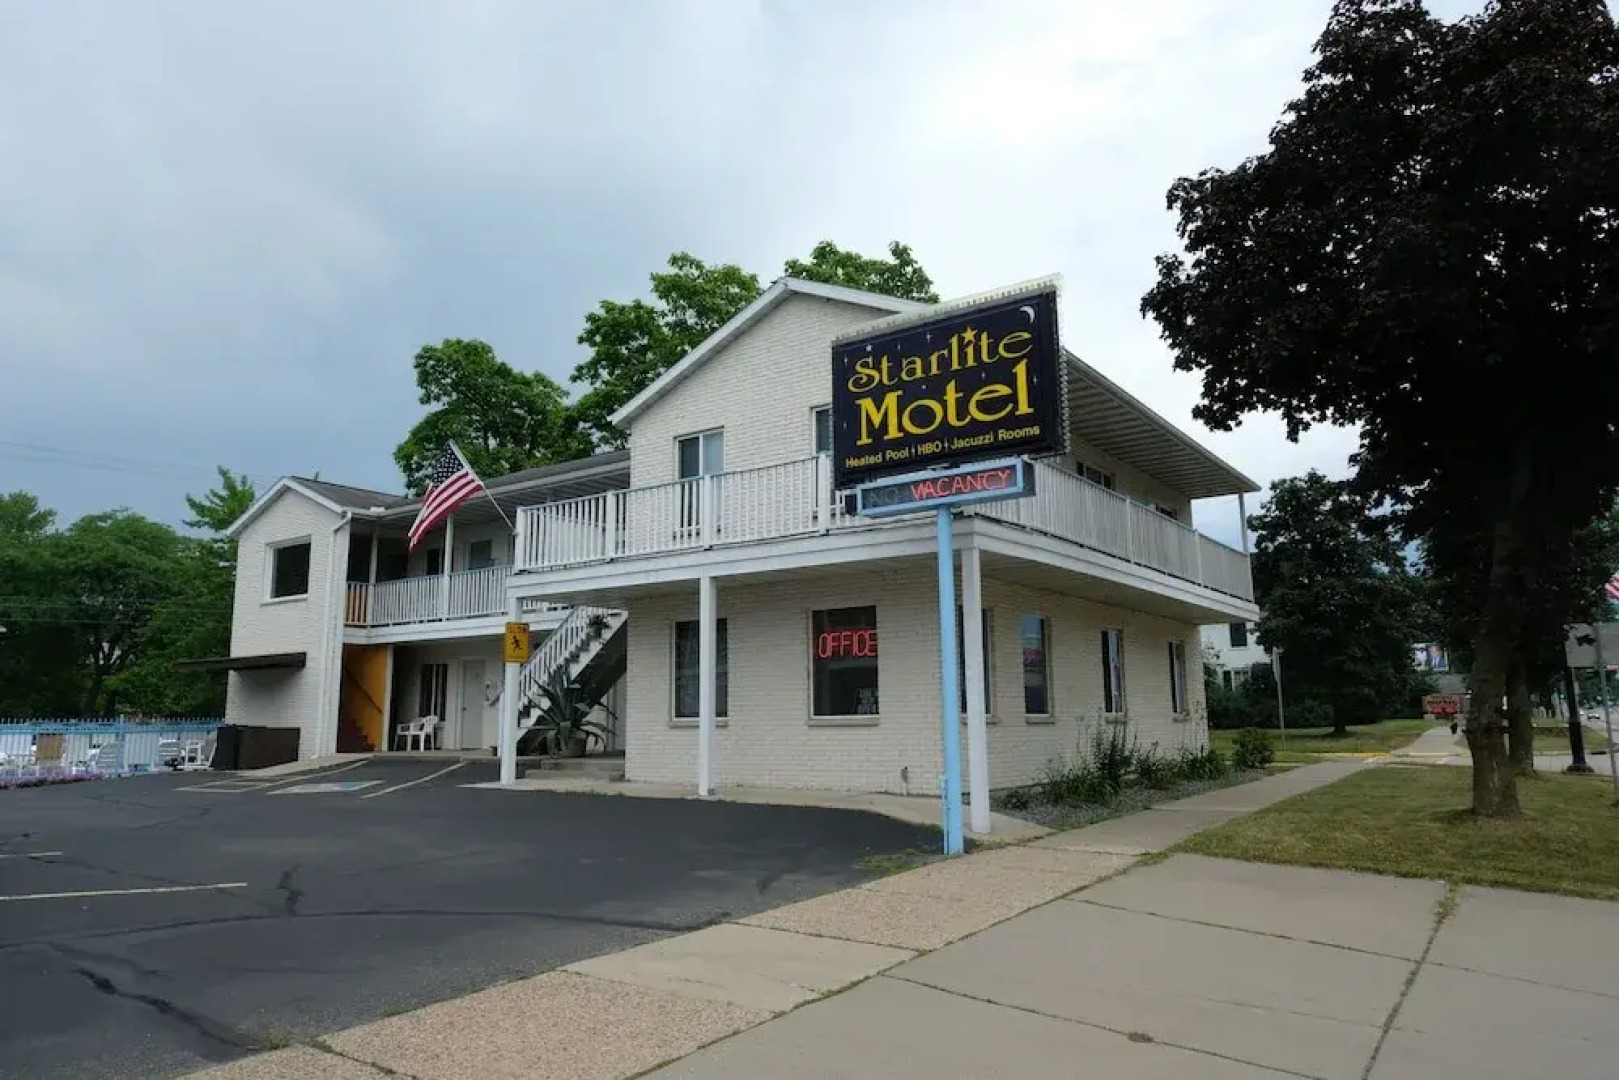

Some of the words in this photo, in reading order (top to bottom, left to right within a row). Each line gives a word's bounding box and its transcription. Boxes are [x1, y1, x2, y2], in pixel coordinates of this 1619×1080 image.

[847, 326, 1033, 392] Starlite
[855, 358, 1035, 446] Motel
[845, 452, 883, 468] Heated
[885, 448, 909, 463] Pool
[917, 441, 942, 456] HBO
[950, 432, 994, 448] Jacuzzi
[998, 425, 1040, 441] Rooms
[911, 469, 1011, 500] VACANCY
[818, 629, 878, 658] OFFICE
